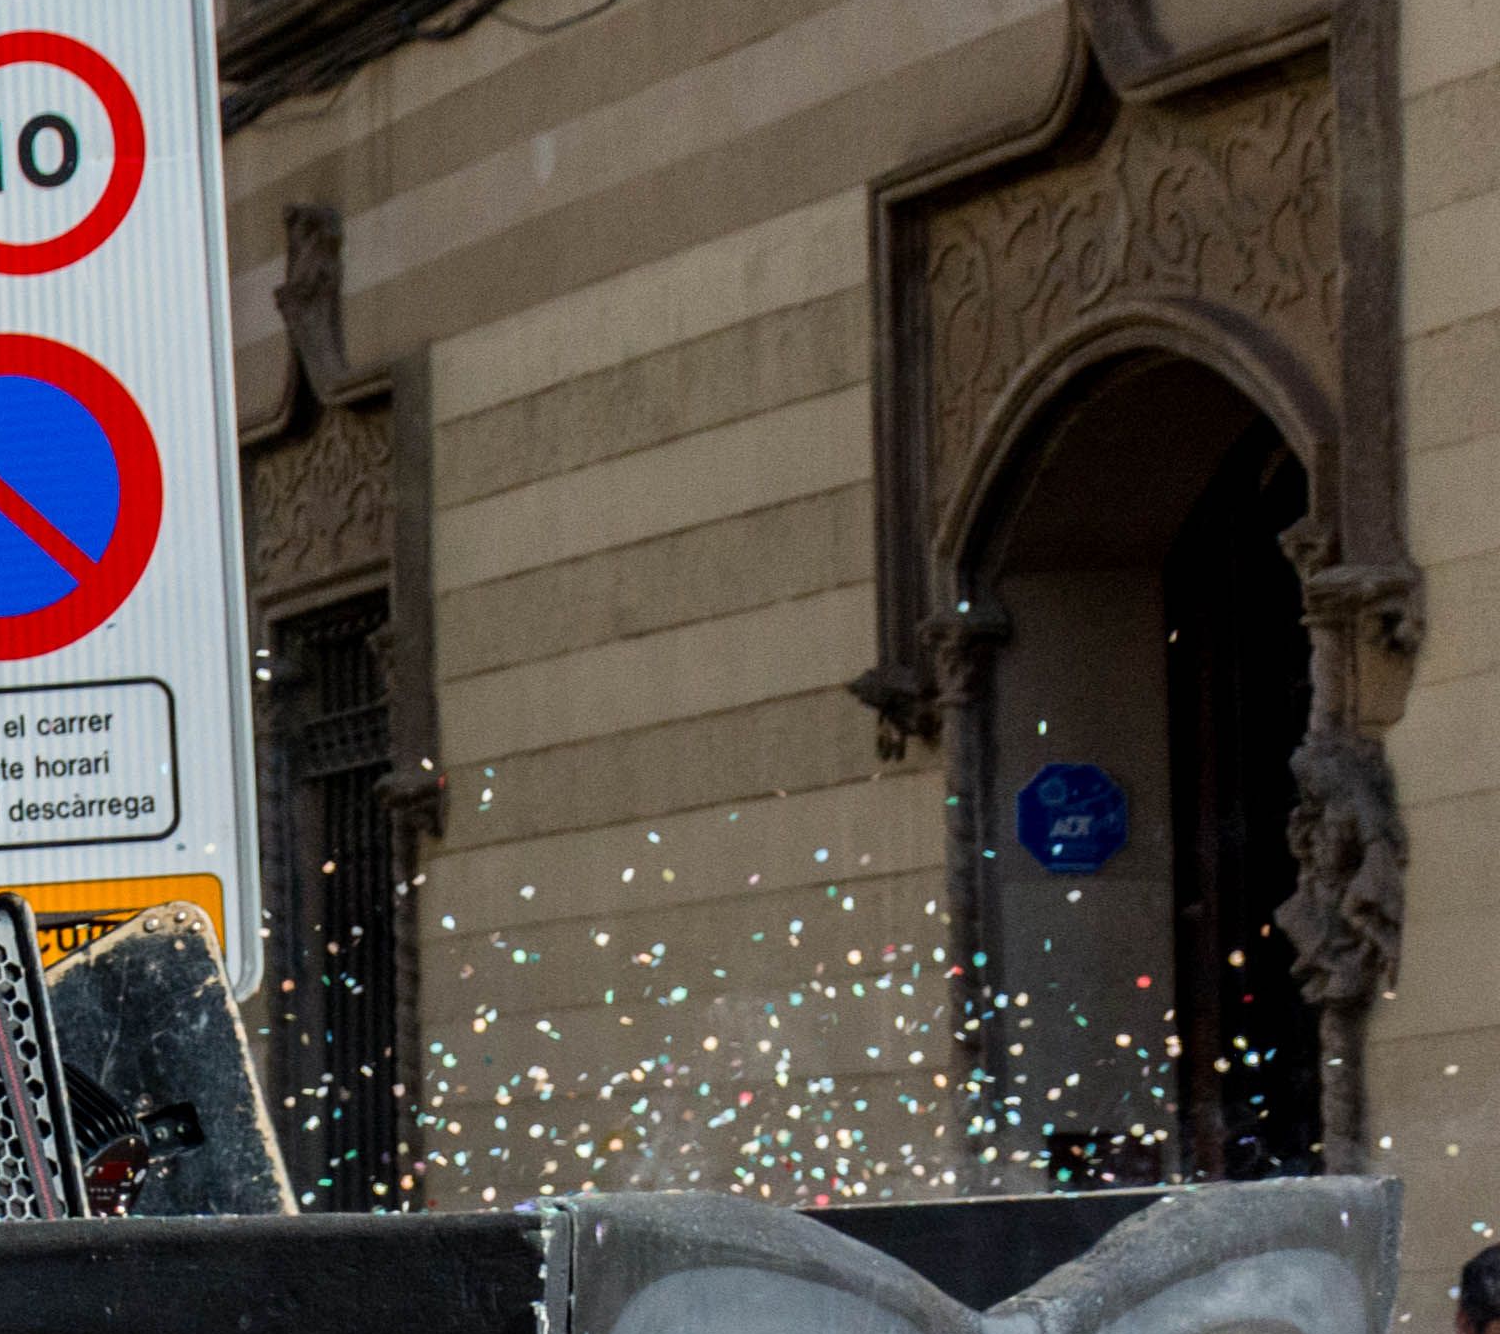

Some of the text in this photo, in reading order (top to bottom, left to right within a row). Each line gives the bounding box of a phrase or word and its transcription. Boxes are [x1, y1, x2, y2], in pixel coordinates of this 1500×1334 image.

[4, 715, 26, 738] el
[37, 713, 113, 735] carrer
[35, 749, 110, 779] horari
[8, 793, 156, 823] descàrrega
